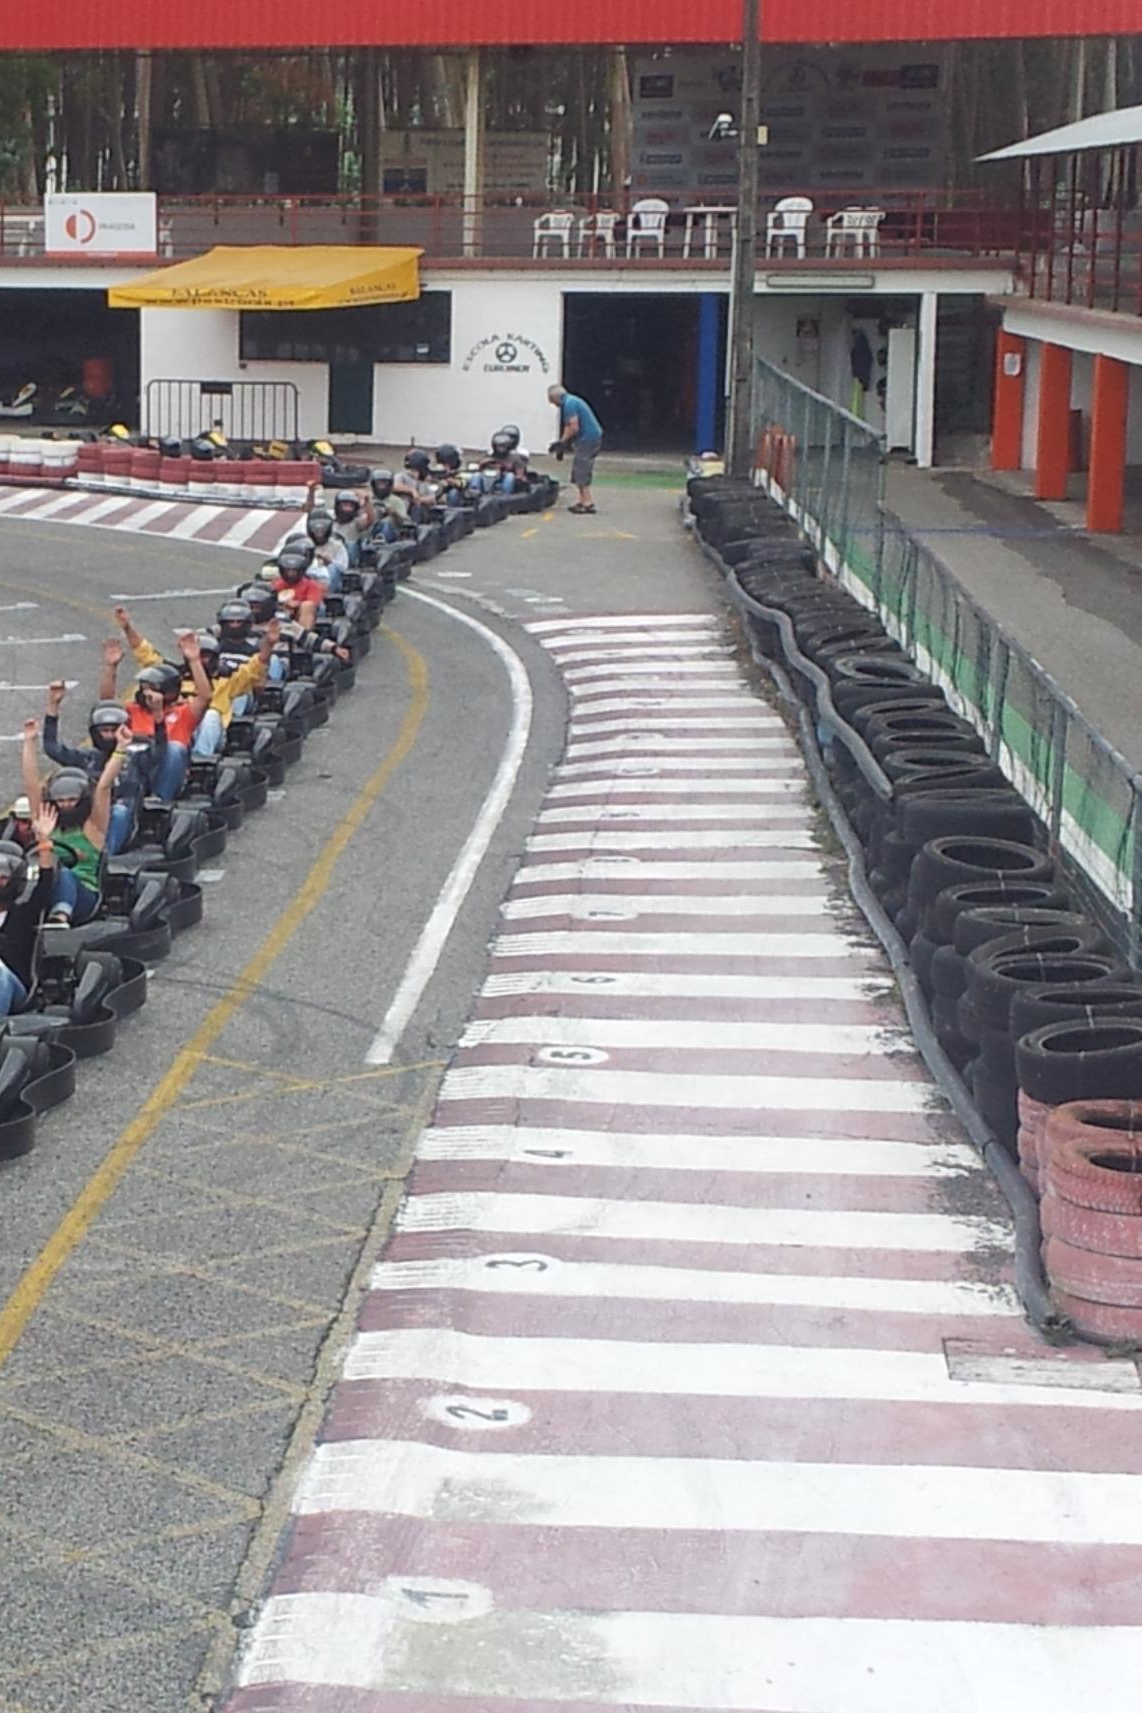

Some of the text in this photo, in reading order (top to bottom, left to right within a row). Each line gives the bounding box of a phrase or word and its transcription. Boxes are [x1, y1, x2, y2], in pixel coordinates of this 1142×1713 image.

[462, 333, 550, 374] ESCOLA KARTING
[550, 1050, 592, 1060] 5
[484, 1259, 549, 1273] 3
[445, 1404, 509, 1422] 2
[401, 1588, 470, 1609] 1
